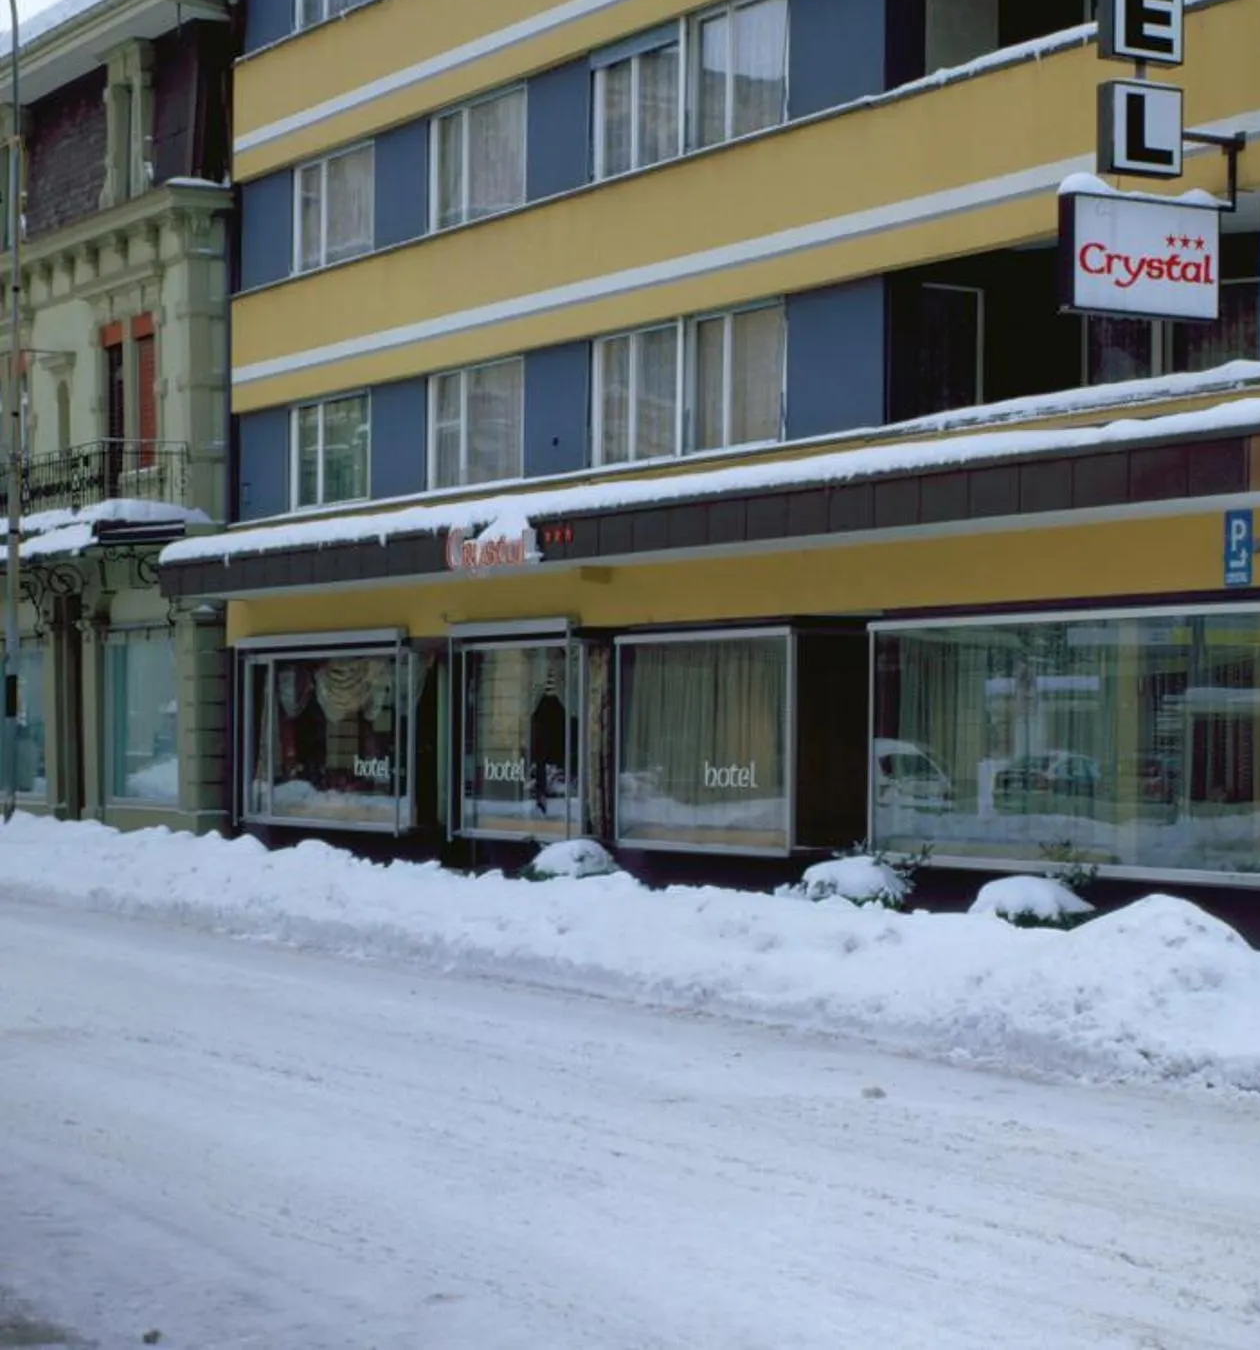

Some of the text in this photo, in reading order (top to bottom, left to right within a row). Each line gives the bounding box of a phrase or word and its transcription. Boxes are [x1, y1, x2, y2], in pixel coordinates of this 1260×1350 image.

[1079, 242, 1214, 288] Crystal
[483, 756, 526, 782] hotel
[704, 760, 760, 788] hotel
